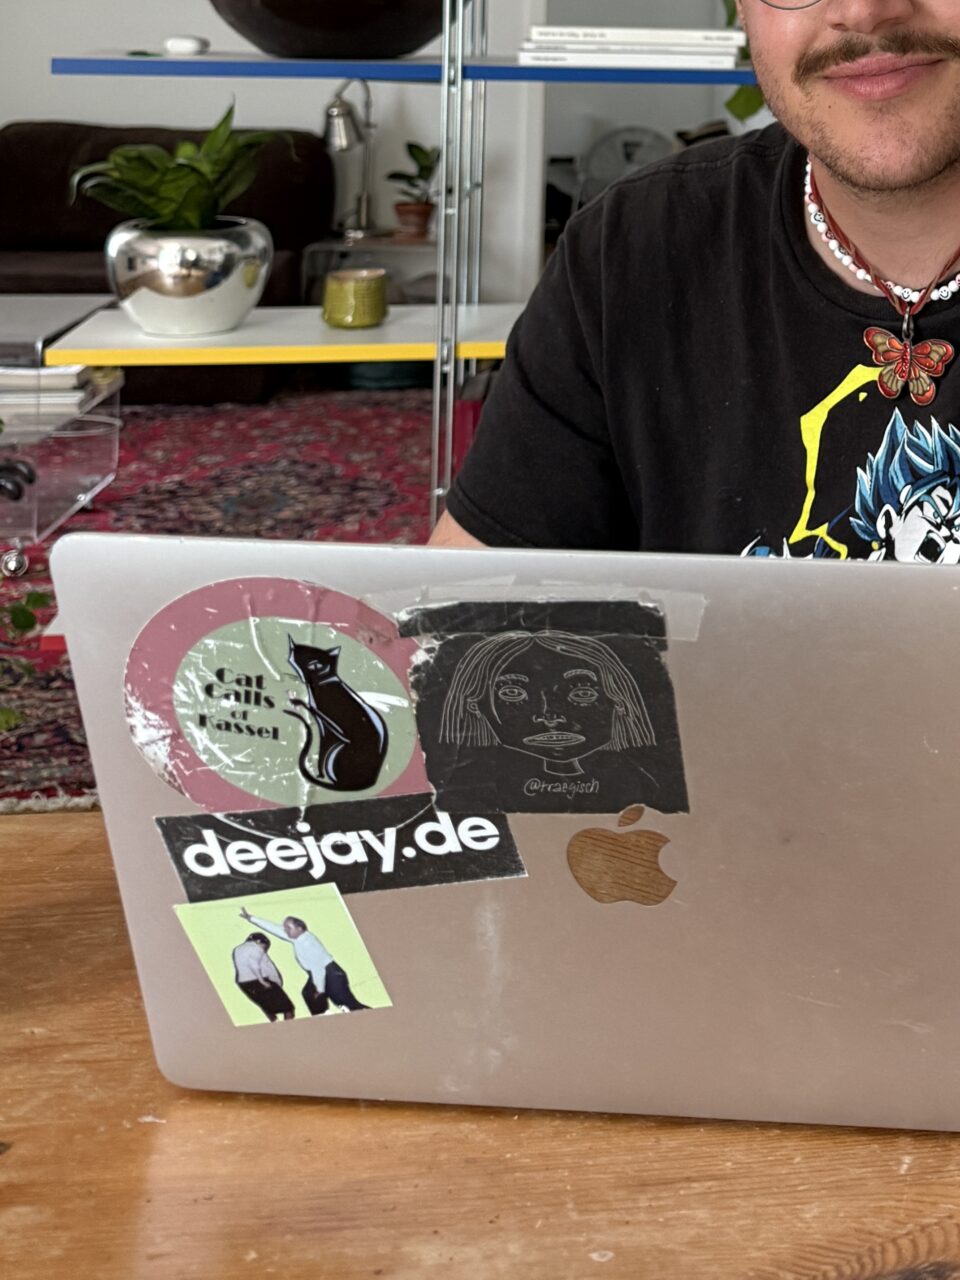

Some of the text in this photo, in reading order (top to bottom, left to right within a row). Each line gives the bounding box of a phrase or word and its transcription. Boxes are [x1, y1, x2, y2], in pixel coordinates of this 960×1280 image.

[215, 667, 267, 690] Cat
[204, 683, 275, 709] Calls
[199, 713, 279, 740] Kassel
[523, 778, 600, 799] @traegisch
[183, 811, 500, 880] deejay.de
